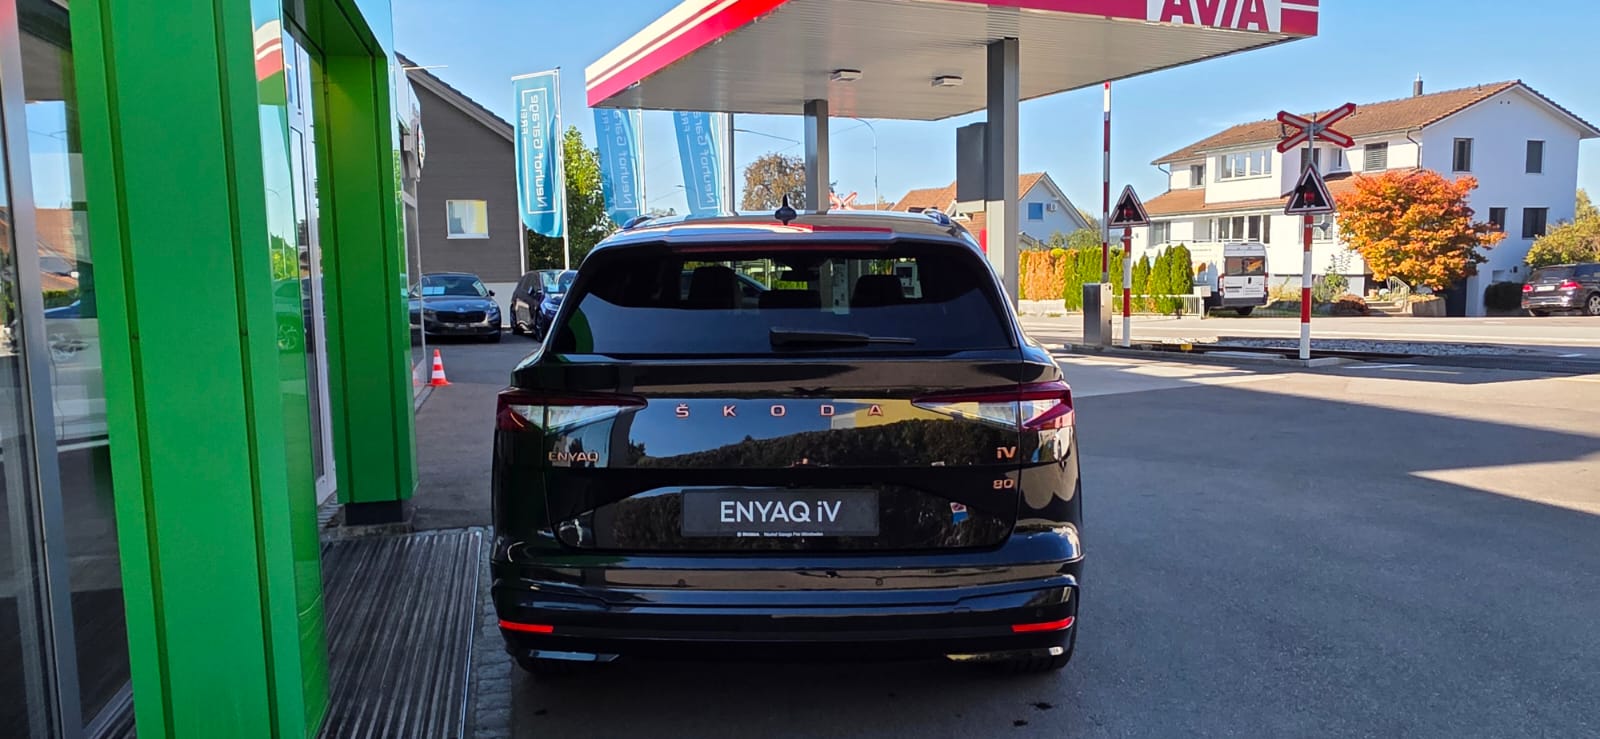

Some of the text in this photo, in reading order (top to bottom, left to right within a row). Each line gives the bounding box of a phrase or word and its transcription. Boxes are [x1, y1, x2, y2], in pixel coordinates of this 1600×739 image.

[1160, 0, 1270, 33] AVIA
[675, 403, 884, 418] ŠKODA
[548, 451, 600, 462] ENYAQ
[996, 446, 1017, 459] iV
[993, 478, 1015, 490] 80
[720, 500, 842, 523] ENYAQ iV
